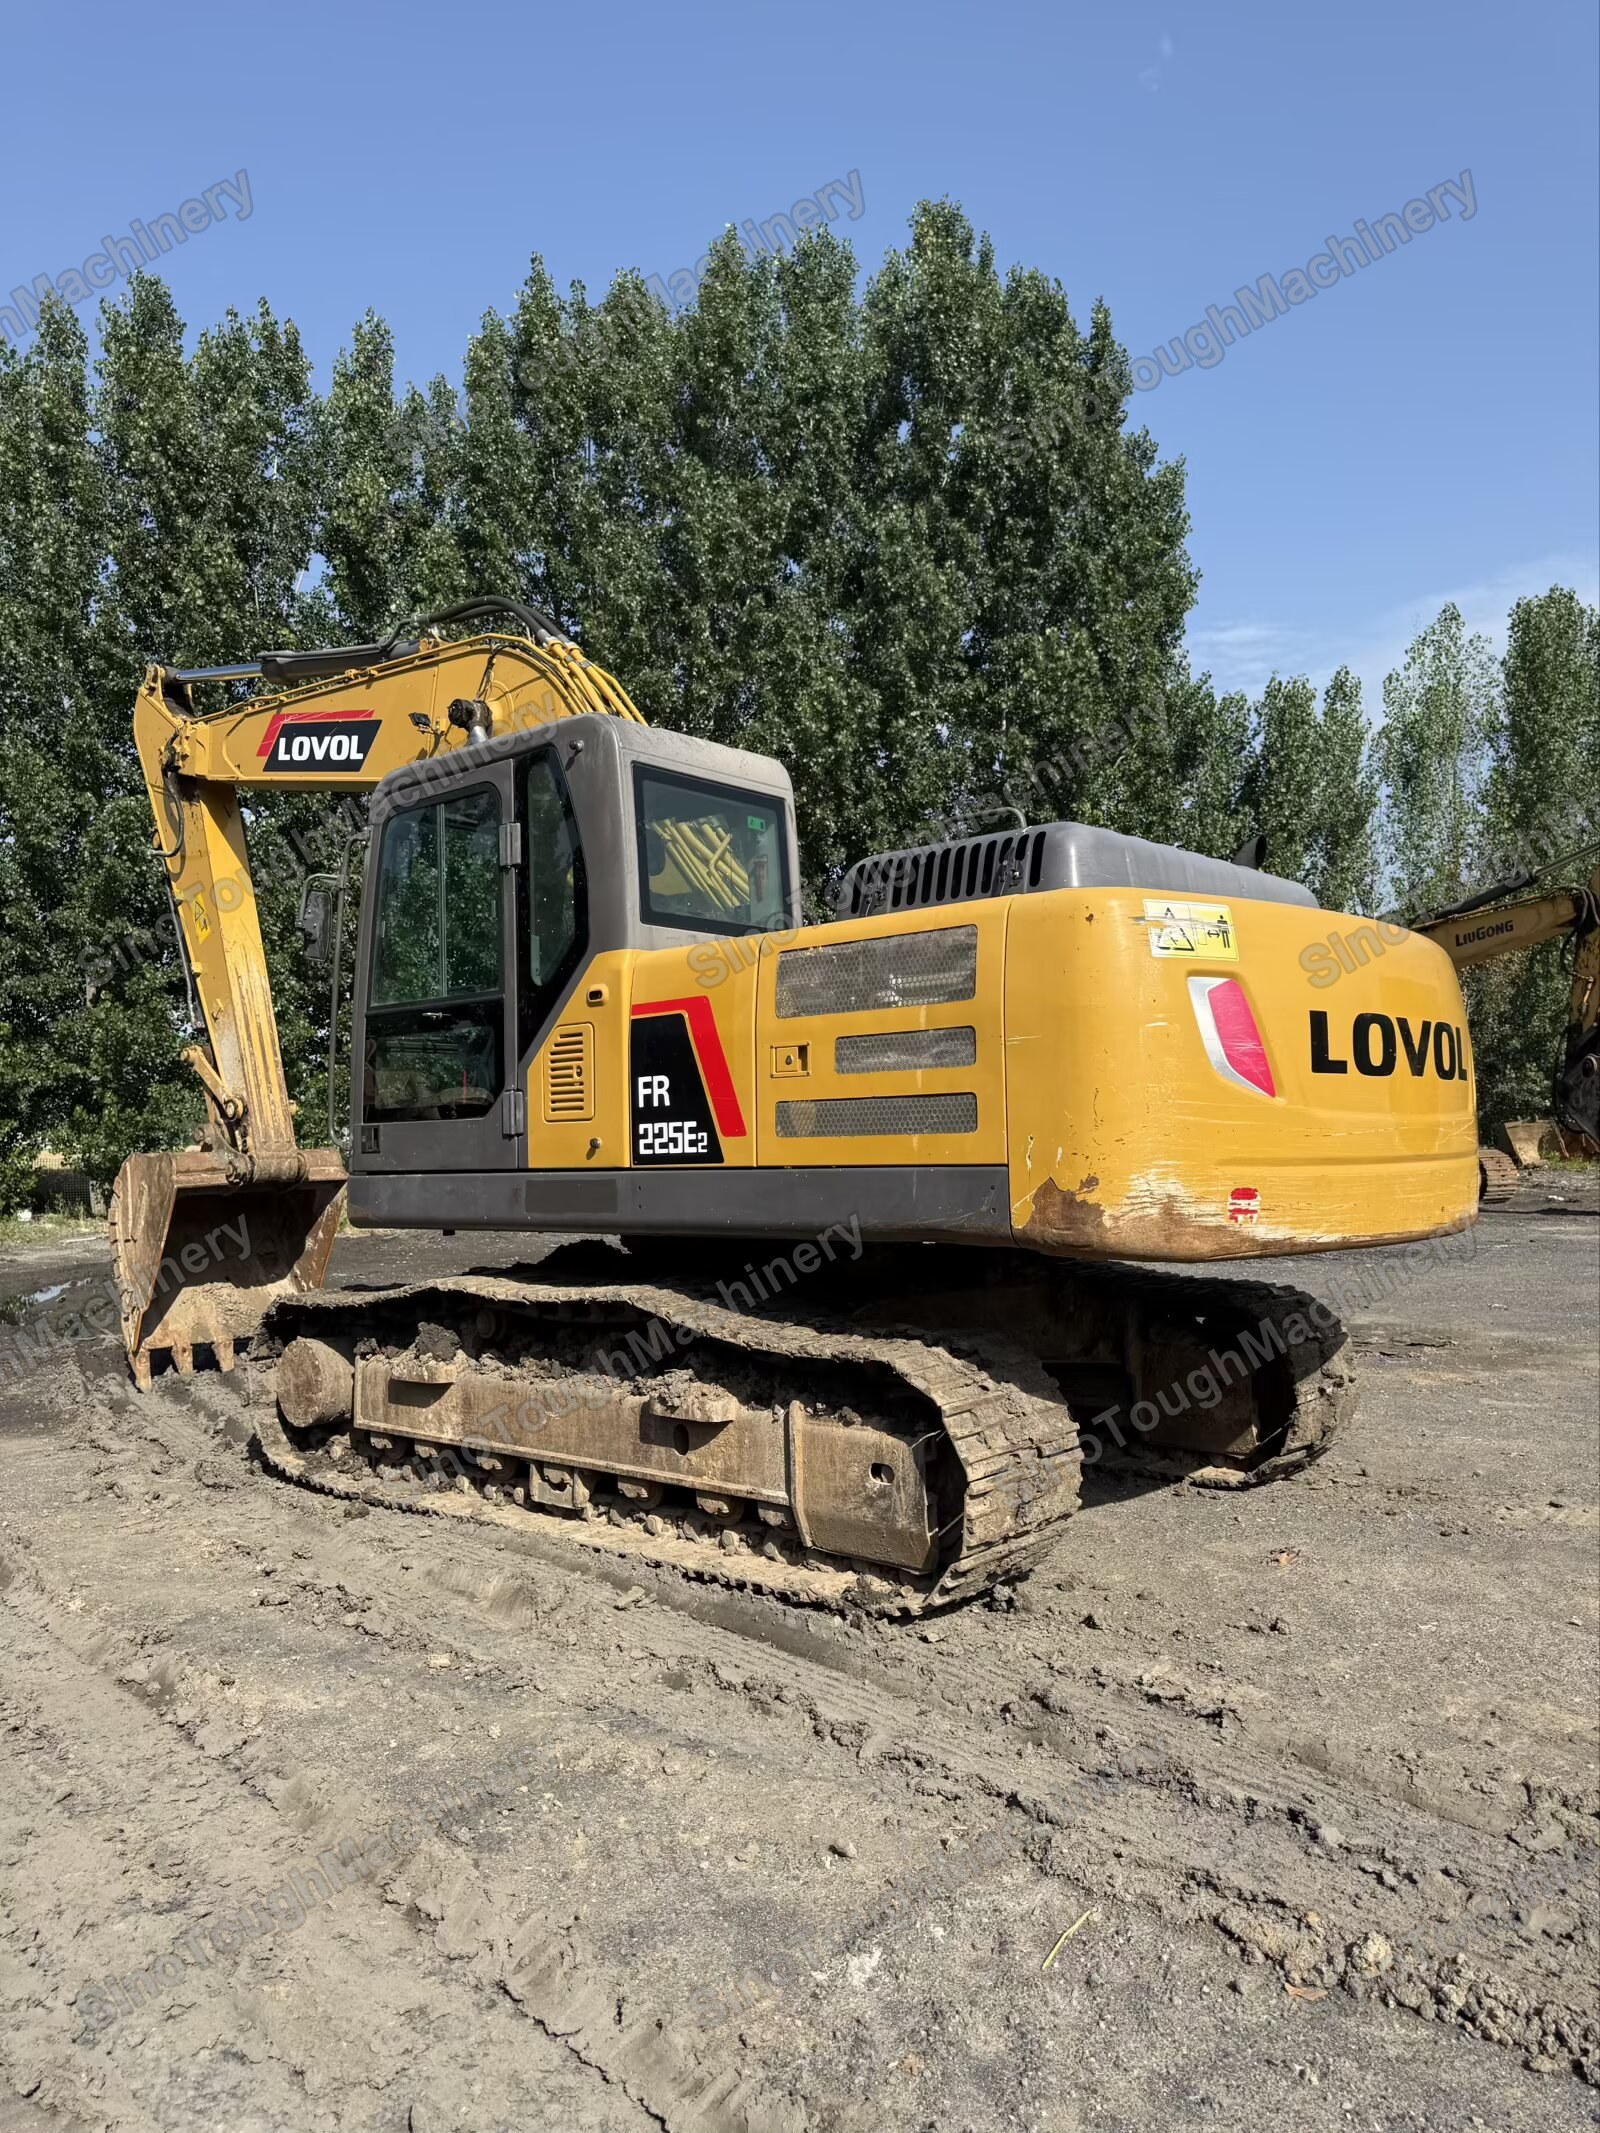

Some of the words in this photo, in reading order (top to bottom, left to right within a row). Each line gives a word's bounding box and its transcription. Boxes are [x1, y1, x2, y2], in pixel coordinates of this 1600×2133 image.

[278, 735, 364, 761] LOVOL
[1309, 1010, 1468, 1081] LOVOL
[638, 1075, 670, 1108] FR
[639, 1121, 708, 1155] 225E2
